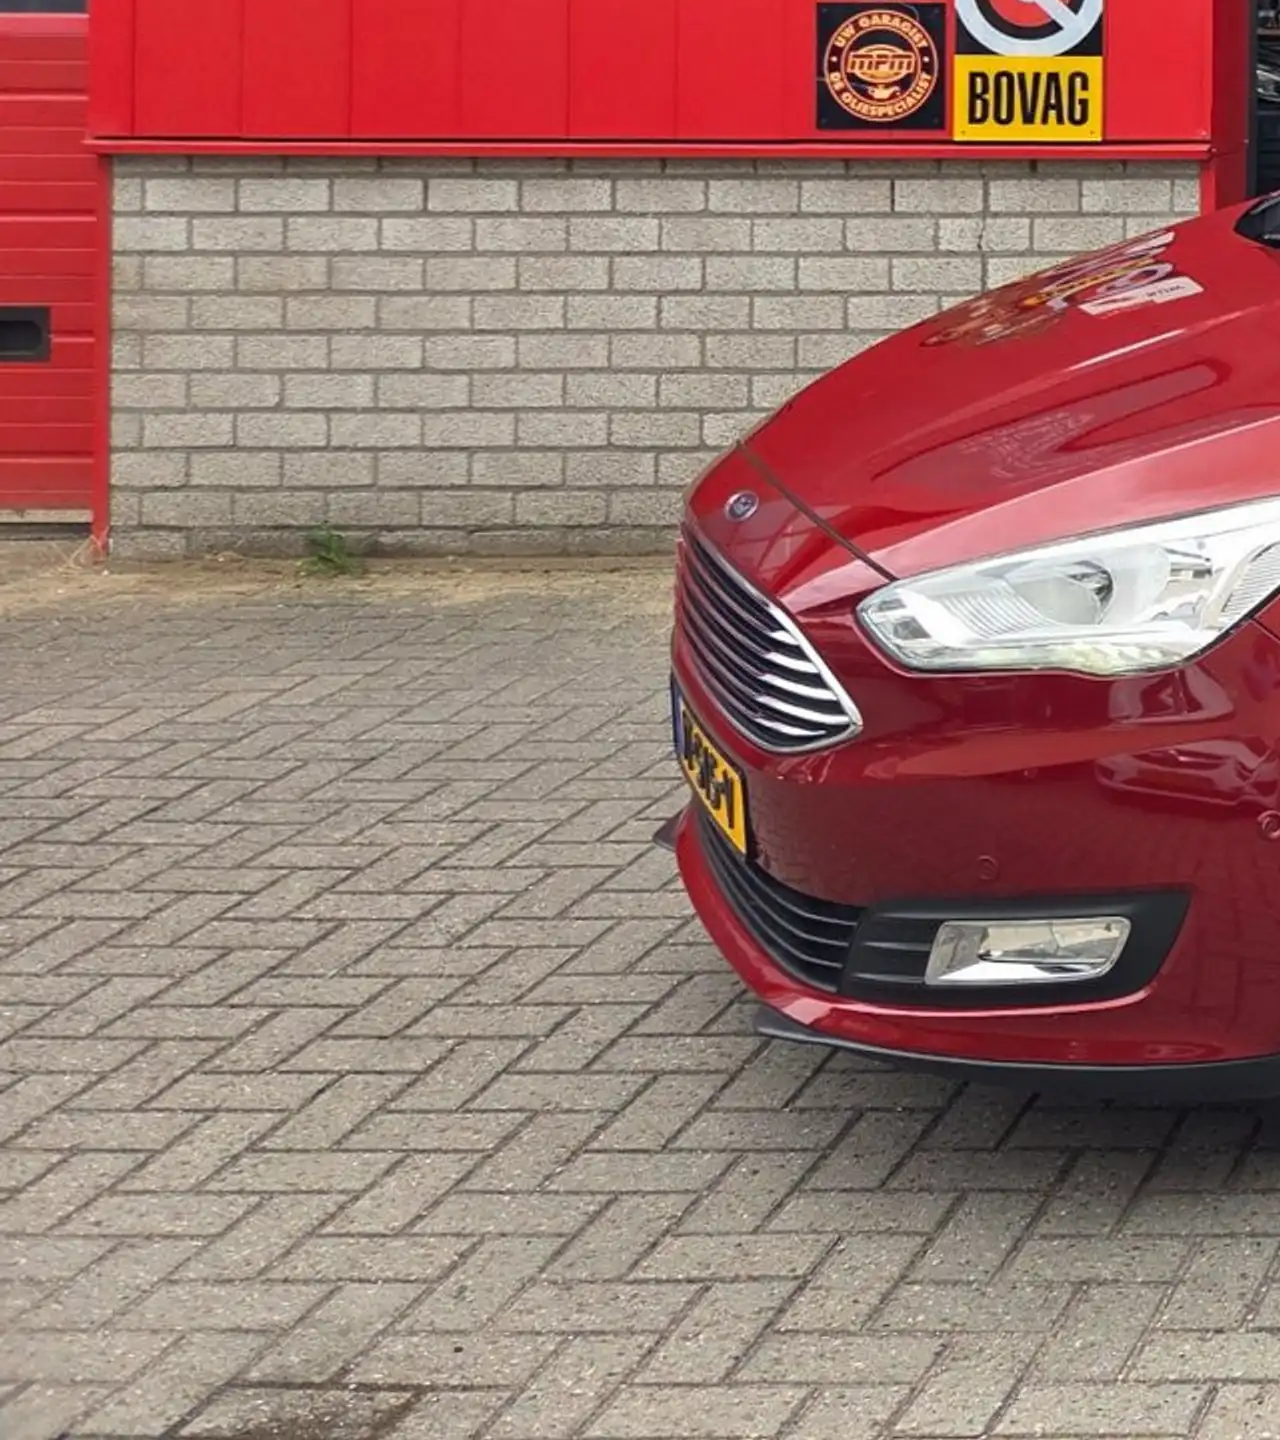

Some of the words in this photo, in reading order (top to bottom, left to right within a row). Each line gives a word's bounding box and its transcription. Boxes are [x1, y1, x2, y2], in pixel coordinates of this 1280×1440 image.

[834, 23, 856, 48] UW
[857, 14, 929, 48] GARAGIST
[829, 71, 845, 91] DE
[968, 70, 1089, 126] BOVAG
